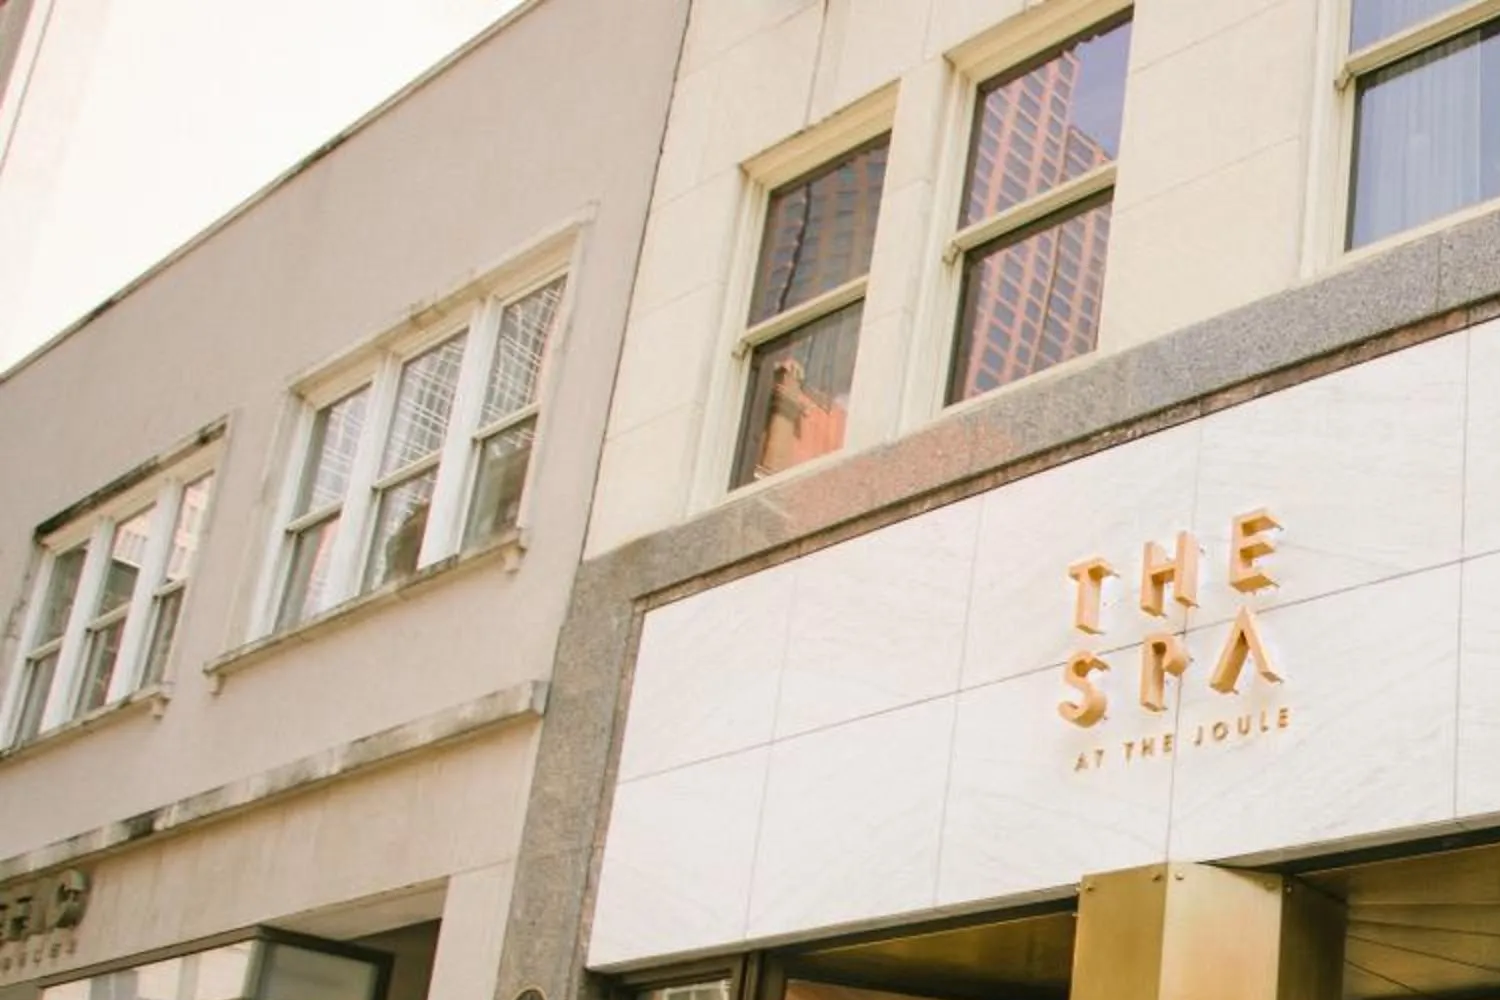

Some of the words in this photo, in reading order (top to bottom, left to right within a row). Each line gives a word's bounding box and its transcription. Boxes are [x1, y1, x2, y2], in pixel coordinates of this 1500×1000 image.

[1067, 507, 1284, 635] THE
[1057, 604, 1284, 728] SPA
[1074, 749, 1105, 772] AT
[1123, 733, 1174, 763] THE
[1193, 707, 1290, 747] JOULE
